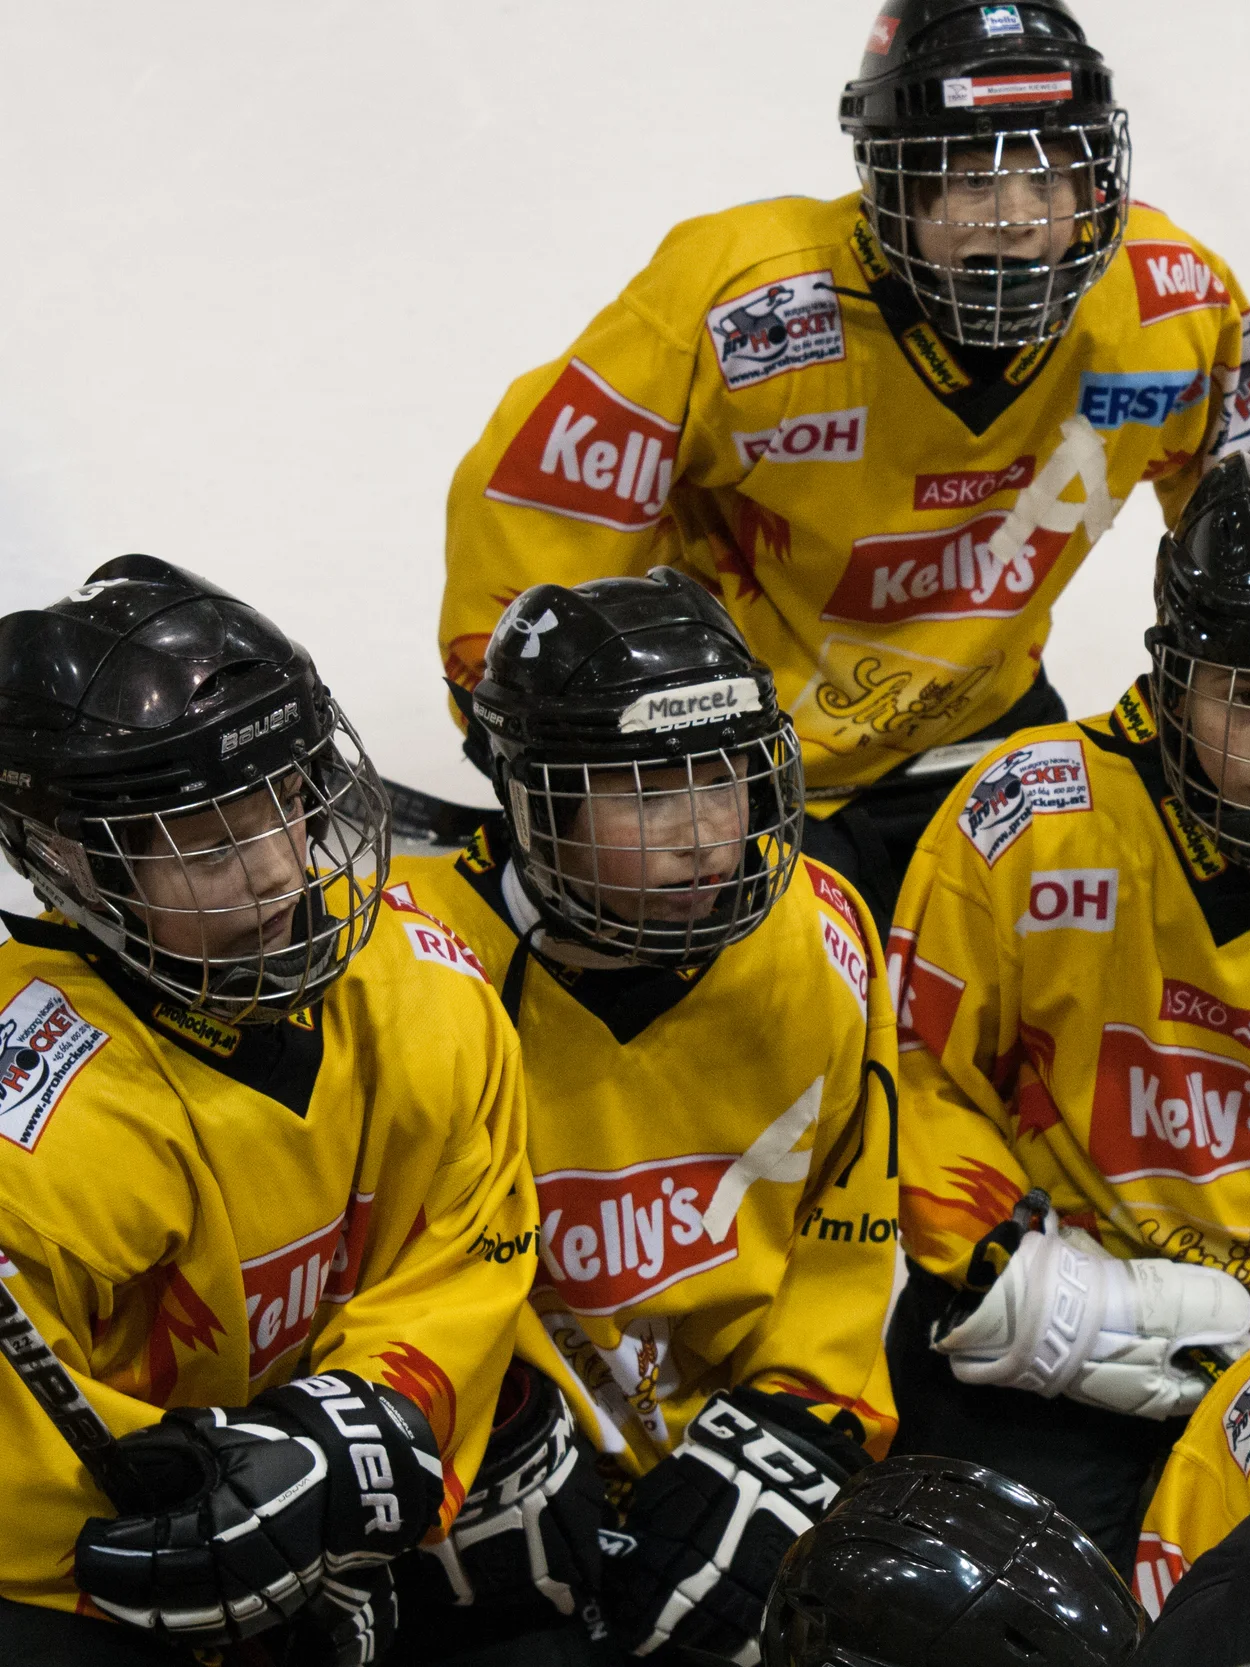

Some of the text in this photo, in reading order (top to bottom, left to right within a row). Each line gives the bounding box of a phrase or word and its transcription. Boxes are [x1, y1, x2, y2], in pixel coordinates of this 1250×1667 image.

[1080, 383, 1185, 426] ERST
[648, 684, 739, 721] Marcel
[220, 700, 300, 755] BAUER
[20, 1029, 103, 1145] www.prohockey.at
